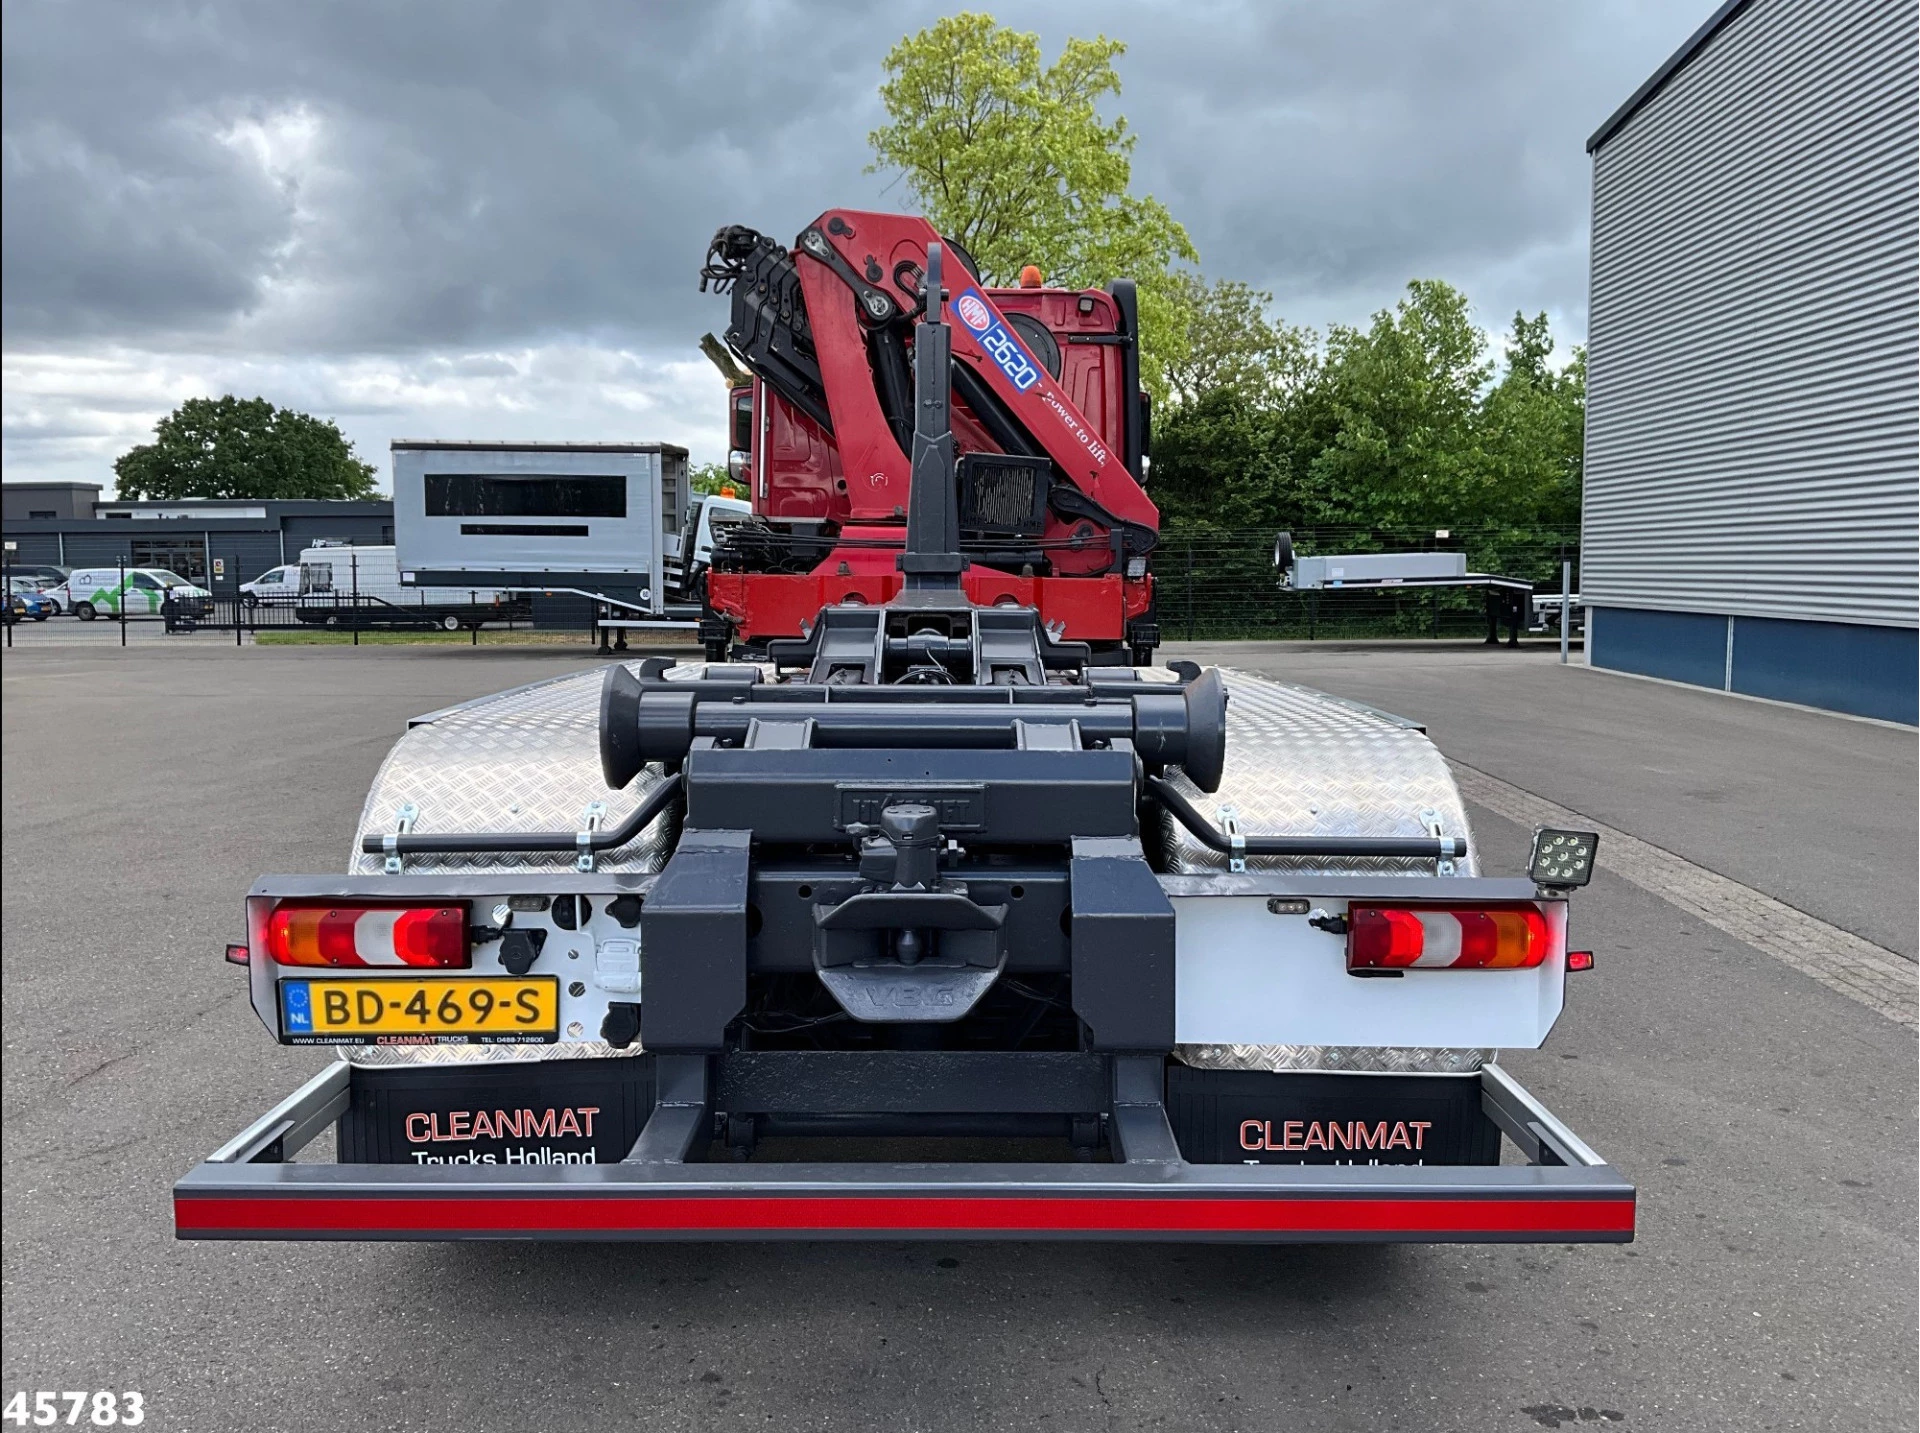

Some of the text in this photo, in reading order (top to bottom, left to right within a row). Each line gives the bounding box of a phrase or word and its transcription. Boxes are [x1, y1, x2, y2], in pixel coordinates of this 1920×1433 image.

[962, 299, 987, 326] HMF
[983, 329, 1036, 389] 2620
[1076, 428, 1089, 443] to
[324, 988, 540, 1025] BD-469-S
[865, 984, 954, 1007] VBG
[291, 1013, 309, 1024] NL
[405, 1107, 600, 1142] CLEANMAT
[1239, 1119, 1431, 1150] CLEANMAT
[411, 1147, 596, 1165] Trucks Holland
